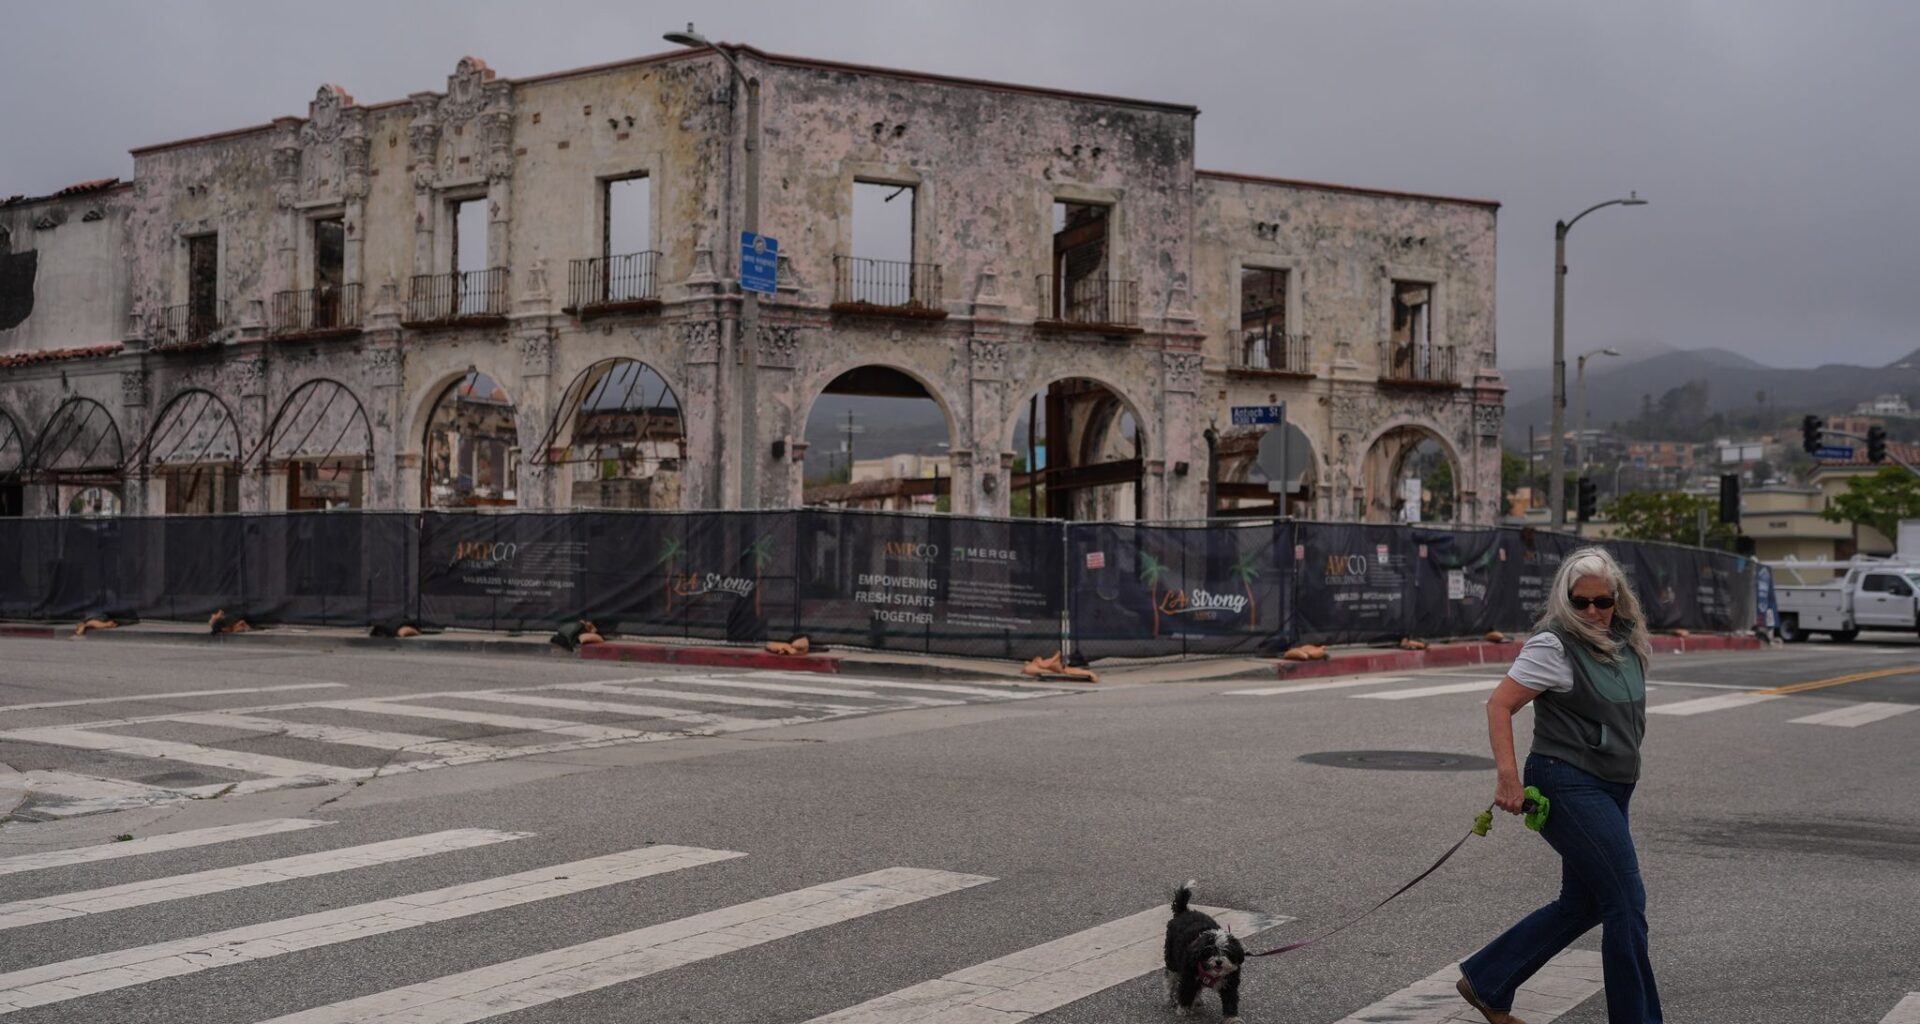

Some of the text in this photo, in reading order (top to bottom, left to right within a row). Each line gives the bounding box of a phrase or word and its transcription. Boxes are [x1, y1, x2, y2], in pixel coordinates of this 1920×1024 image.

[967, 547, 1017, 560] MERGE
[858, 574, 938, 590] EMPOWERING
[855, 591, 892, 604] FRESH
[894, 593, 935, 607] STARTS
[1191, 588, 1248, 613] Strong
[873, 609, 935, 625] TOGETHER
